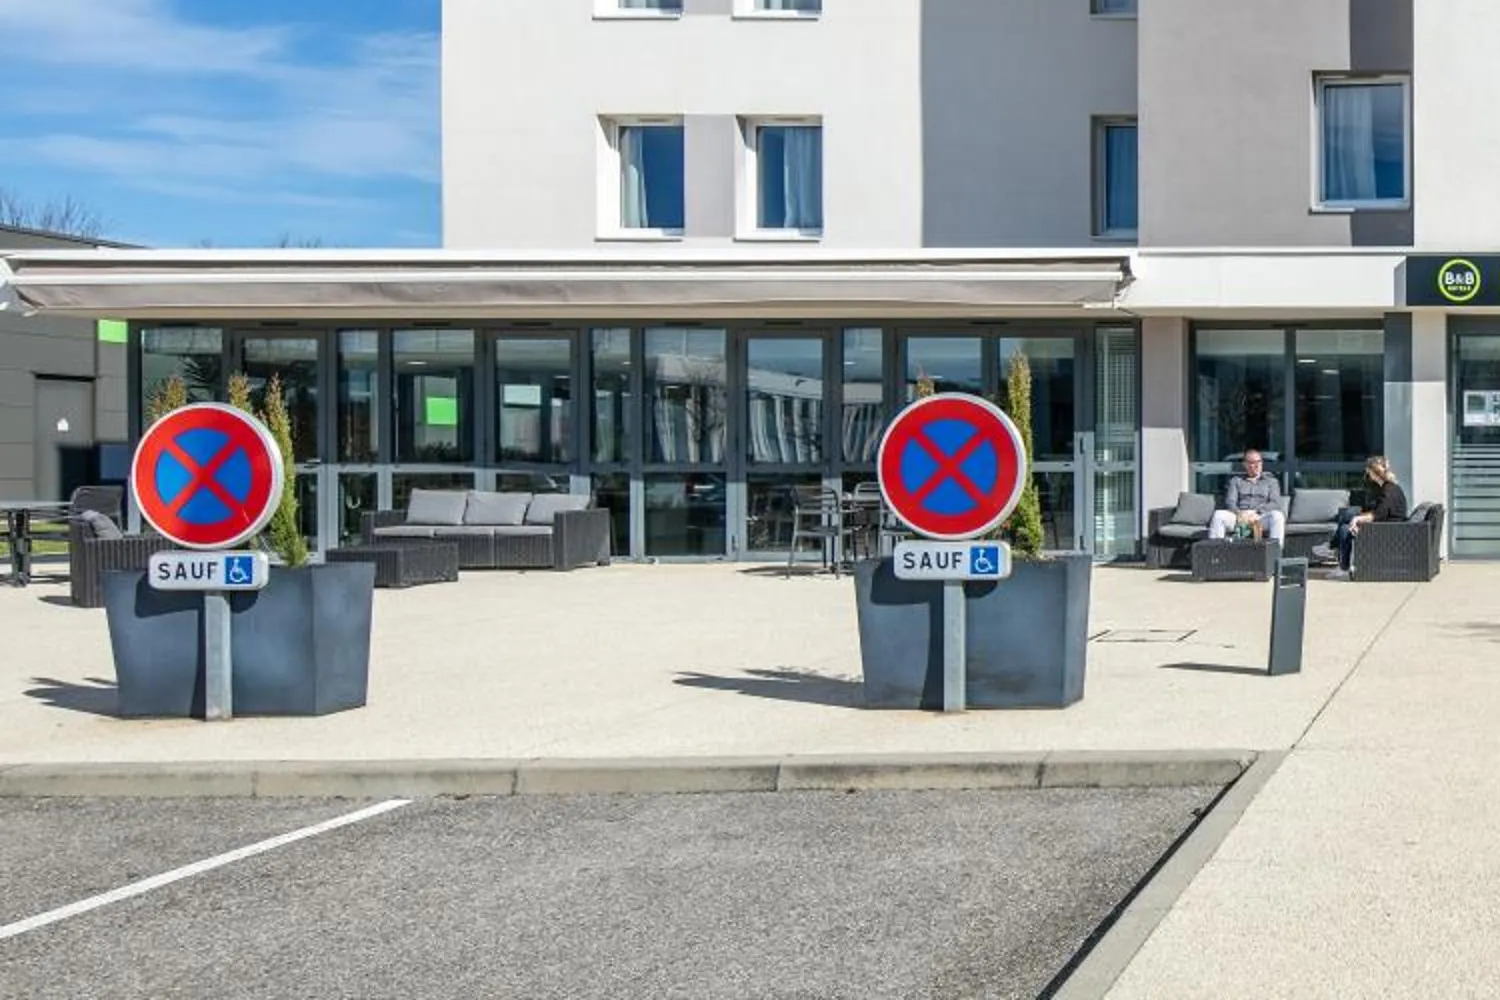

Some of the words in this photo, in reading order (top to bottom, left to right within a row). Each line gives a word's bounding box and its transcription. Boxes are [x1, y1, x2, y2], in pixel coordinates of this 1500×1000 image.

[1445, 271, 1475, 285] B&B
[903, 551, 963, 570] SAUF
[158, 561, 218, 580] SAUF
